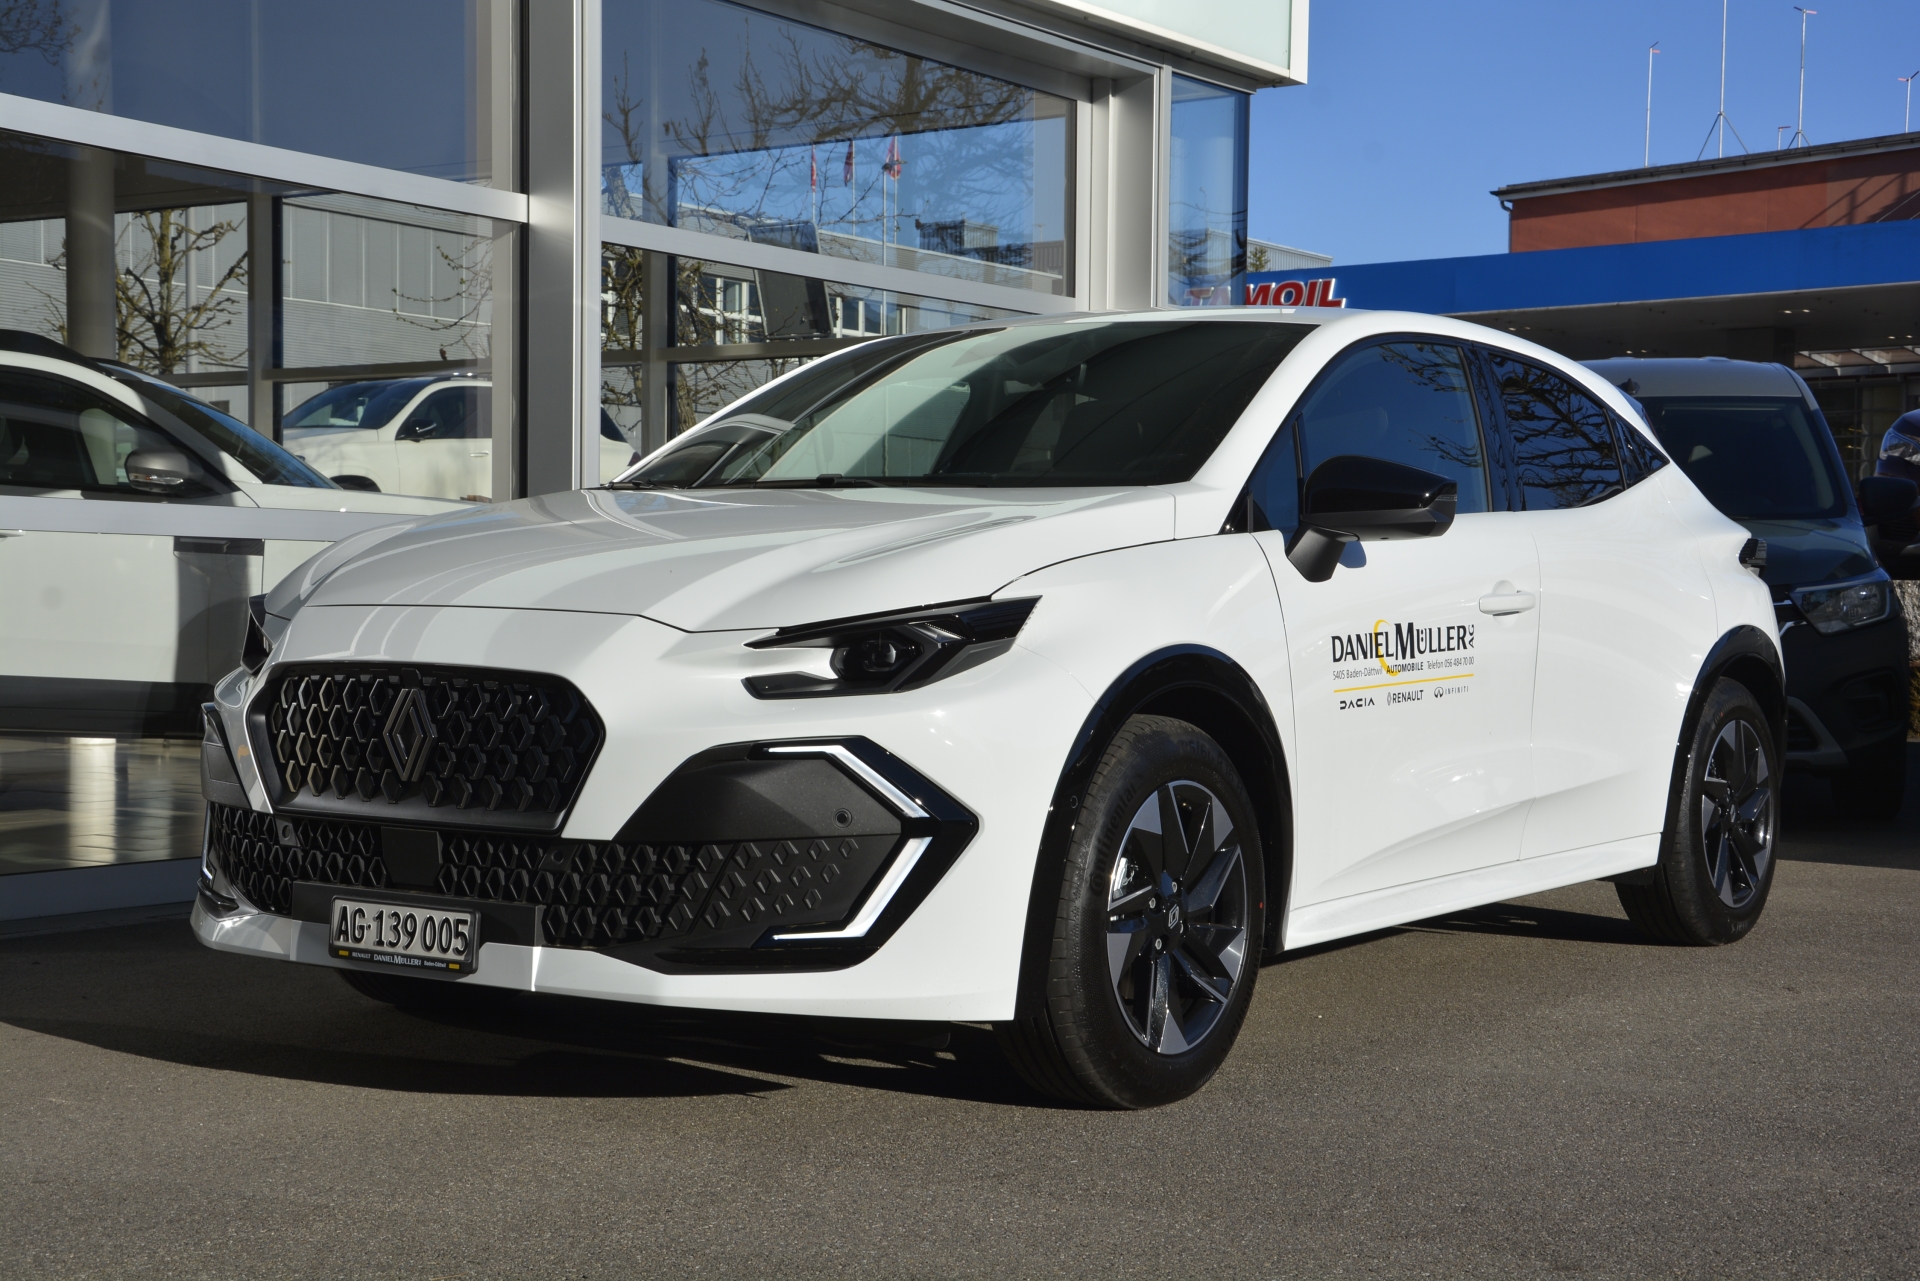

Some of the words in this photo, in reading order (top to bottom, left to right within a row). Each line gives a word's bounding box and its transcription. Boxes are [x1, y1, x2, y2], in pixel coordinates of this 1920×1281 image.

[1333, 668, 1346, 681] 5405
[1386, 661, 1424, 674] AUTOMOBILE
[1426, 659, 1443, 670] Telefon
[1445, 685, 1469, 695] INFINITI
[1340, 697, 1375, 710] DACIA
[1392, 690, 1424, 704] RENAULT
